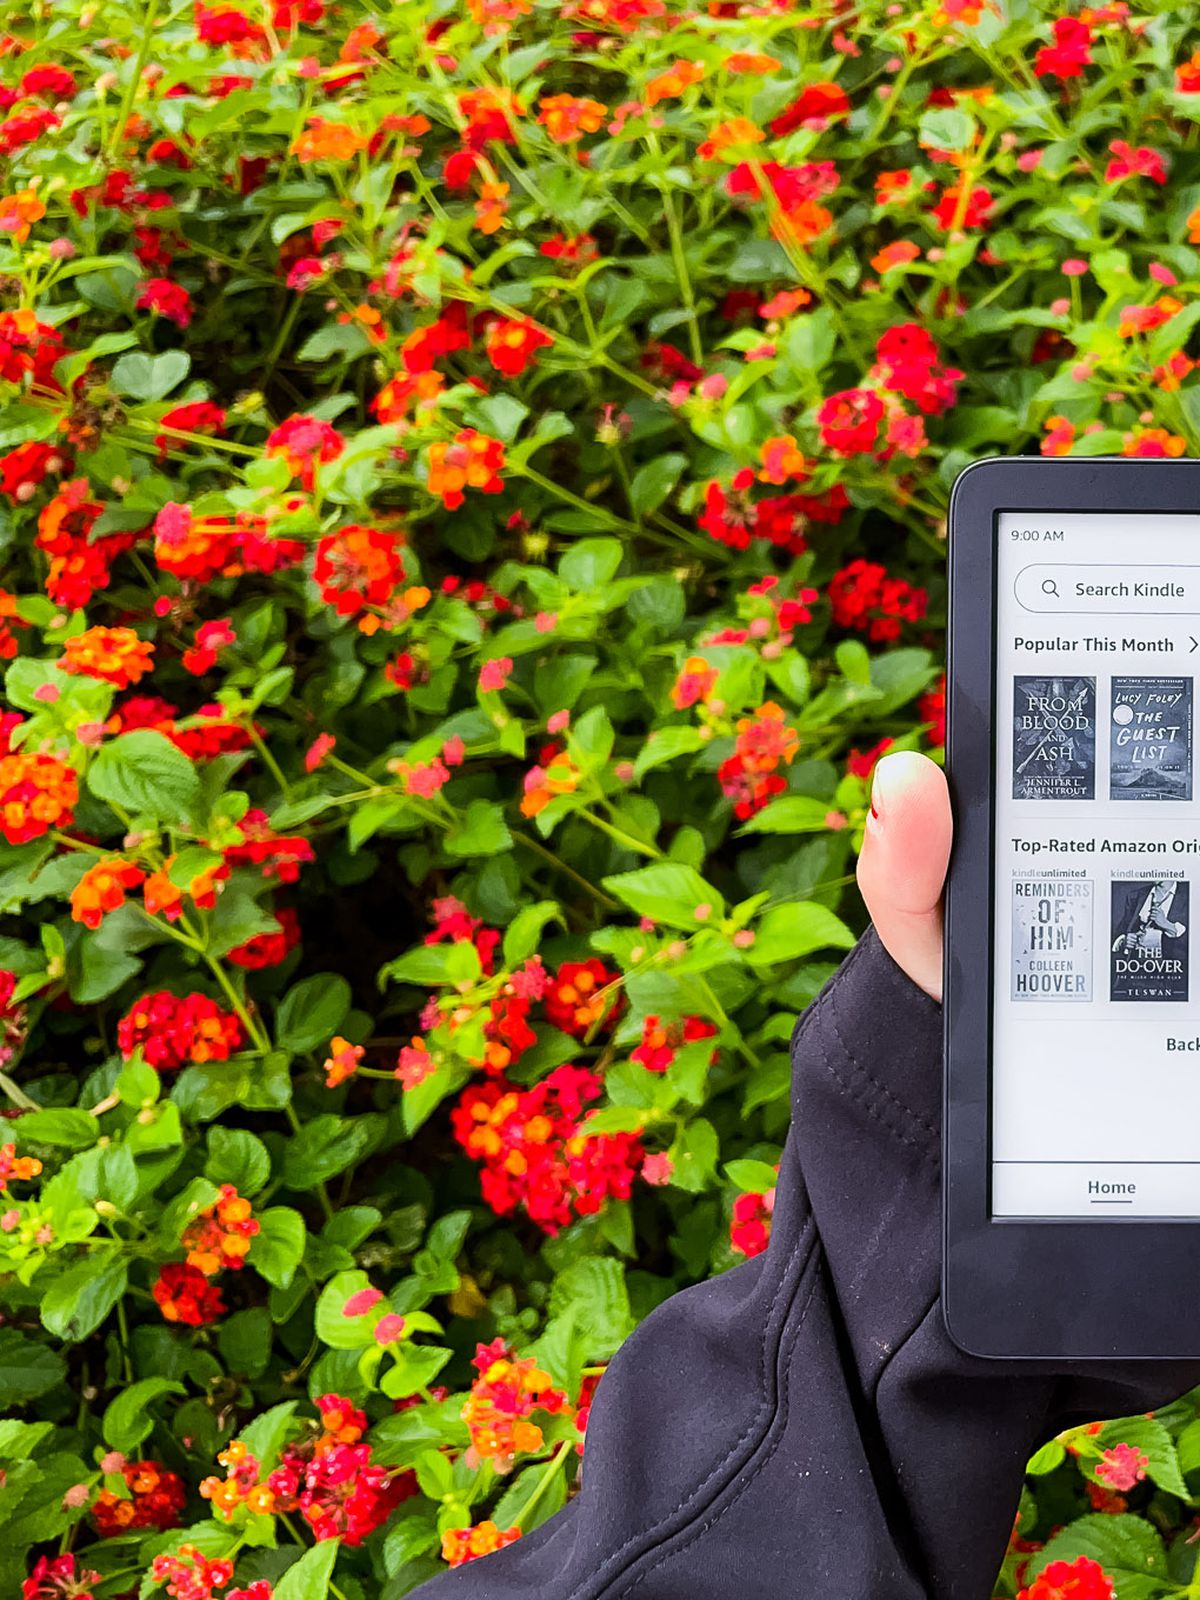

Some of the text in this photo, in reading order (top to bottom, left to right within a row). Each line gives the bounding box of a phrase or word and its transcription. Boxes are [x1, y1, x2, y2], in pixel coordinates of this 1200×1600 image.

[1011, 530, 1065, 542] 9:00 AM
[1075, 582, 1185, 598] Search Kindle
[1014, 637, 1174, 654] Popular This Month
[1026, 697, 1083, 712] FROM
[1115, 692, 1183, 708] LUCY FOLEY
[1022, 715, 1089, 731] BLOOD
[1135, 711, 1163, 724] THE
[1045, 734, 1066, 742] AND
[1116, 726, 1181, 746] GUEST
[1035, 746, 1073, 761] ASH
[1132, 745, 1168, 763] LIST
[1026, 778, 1071, 788] JENNIFER
[1020, 786, 1088, 796] ARMENTROUT
[1012, 838, 1096, 854] Top-Rated
[1100, 839, 1167, 854] Amazon
[1012, 869, 1087, 878] kindleunlimited
[1110, 870, 1184, 879] kindleunlimited
[1015, 883, 1090, 898] REMINDERS
[1038, 899, 1067, 924] OF
[1031, 926, 1074, 950] HIM
[1136, 947, 1162, 959] THE
[1029, 960, 1073, 971] COLLEEN
[1115, 960, 1183, 973] DO-OVER
[1017, 974, 1086, 992] HOOVER
[1088, 1180, 1136, 1194] Home
